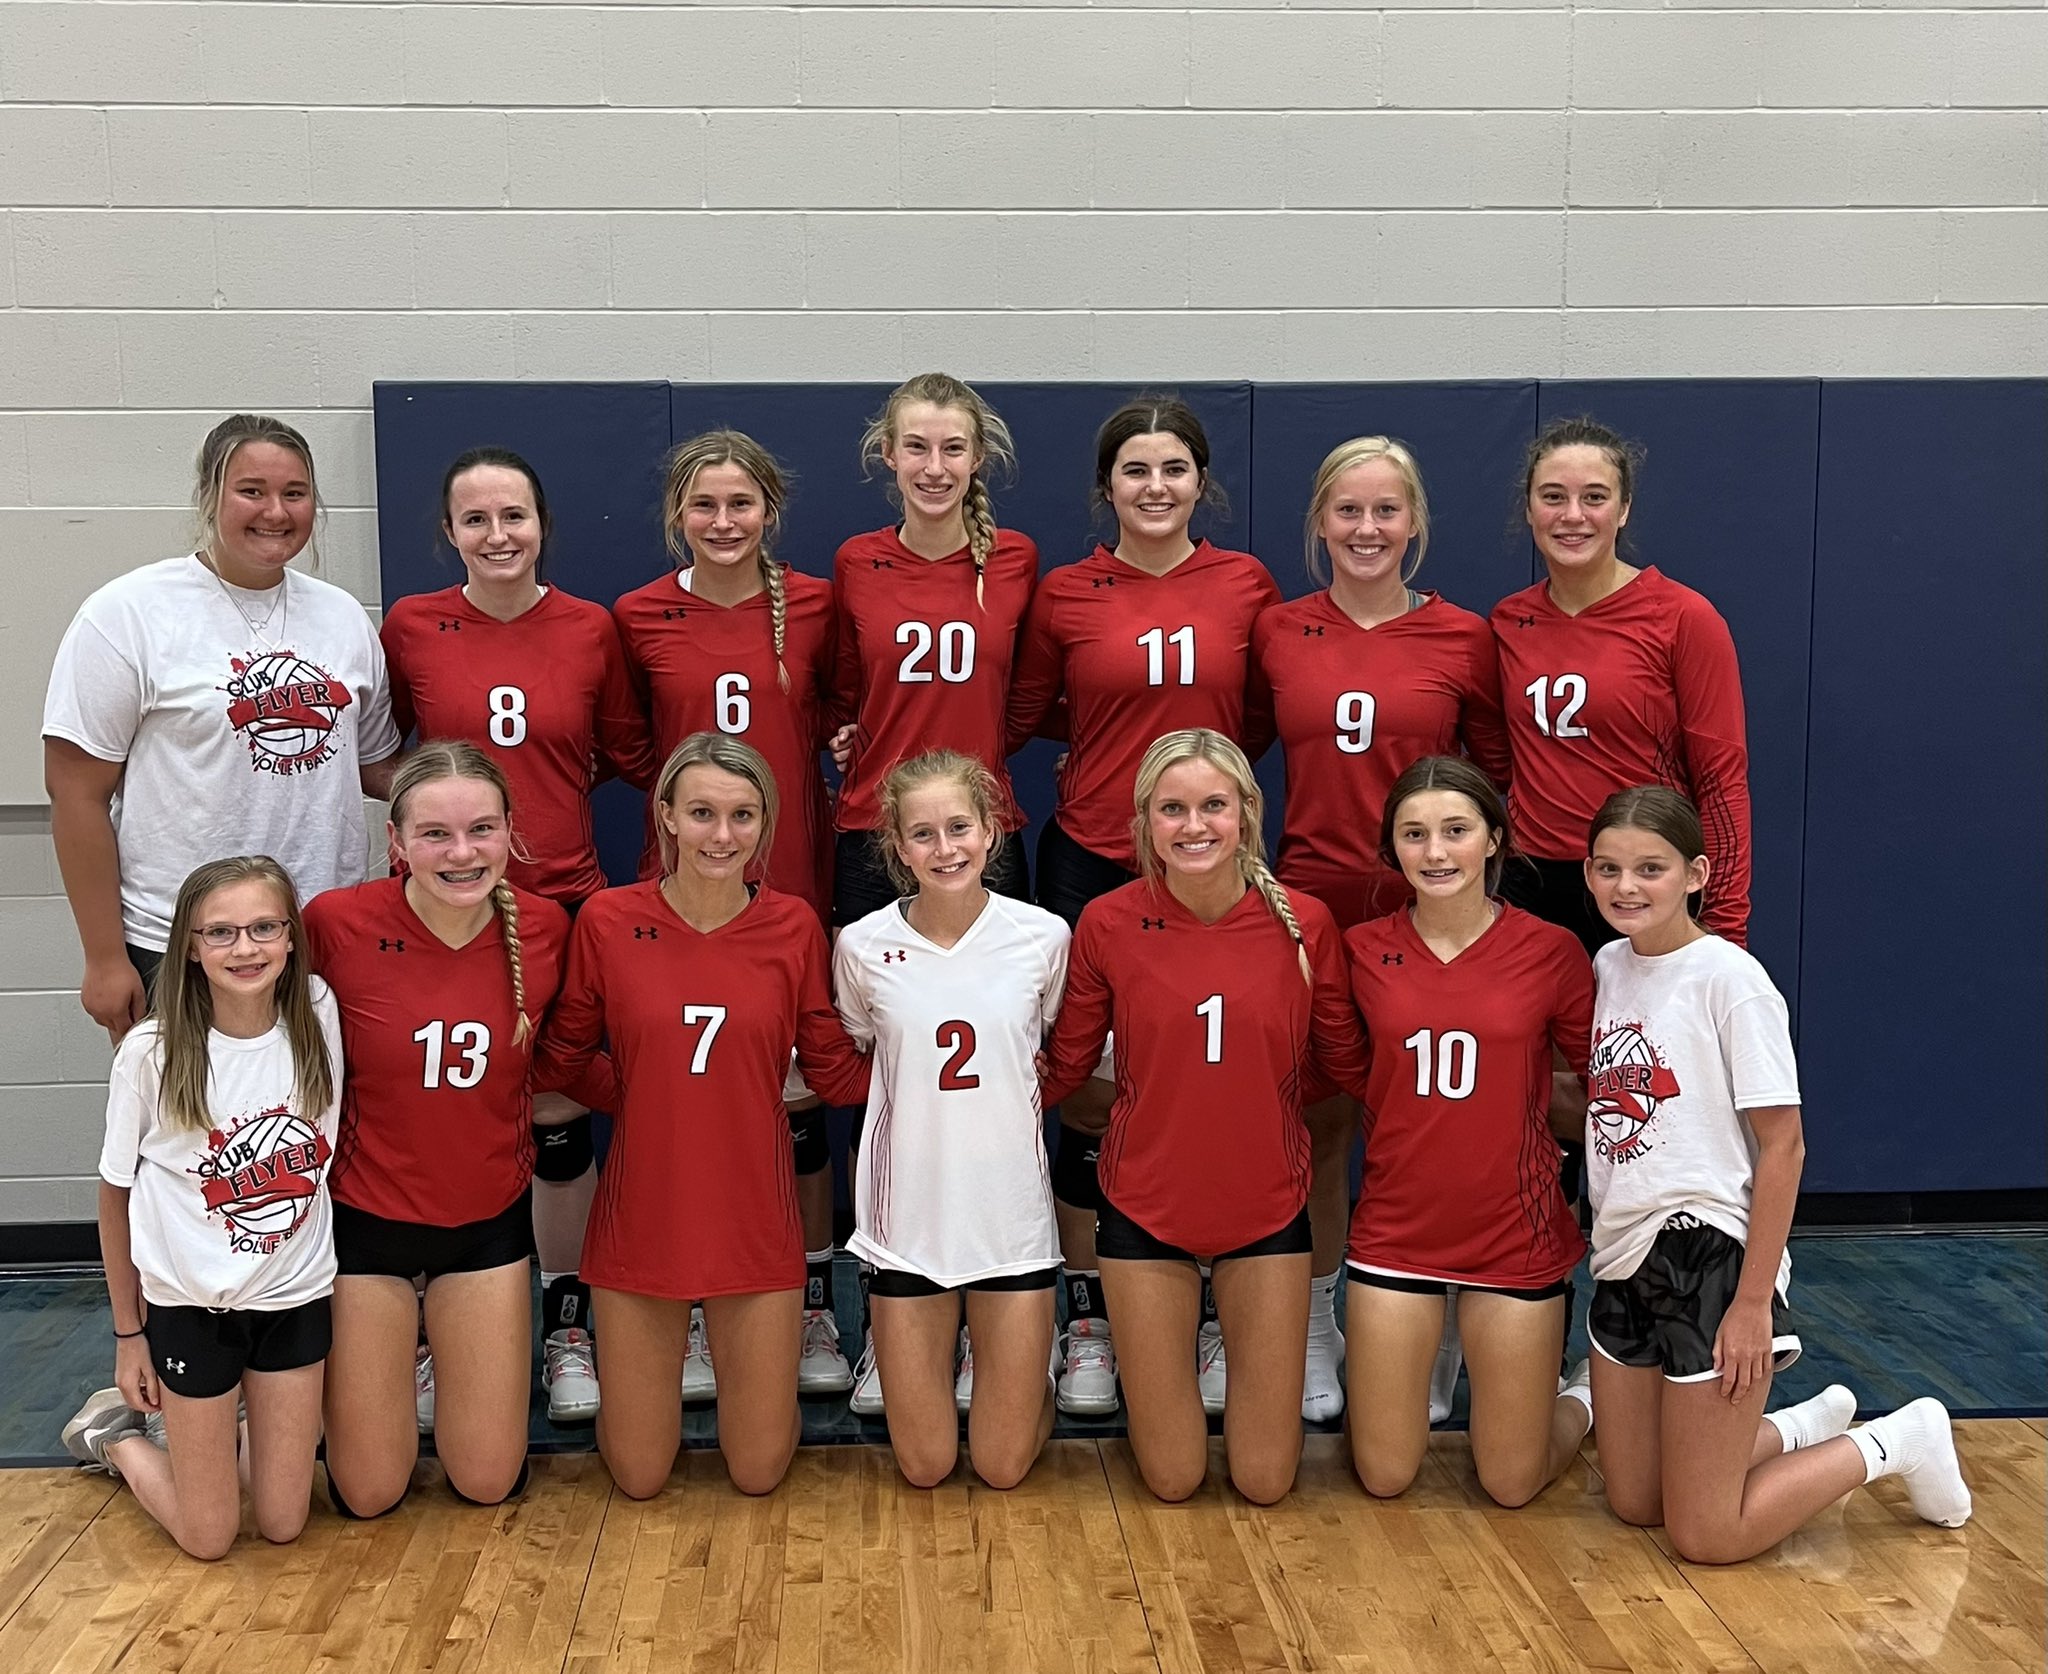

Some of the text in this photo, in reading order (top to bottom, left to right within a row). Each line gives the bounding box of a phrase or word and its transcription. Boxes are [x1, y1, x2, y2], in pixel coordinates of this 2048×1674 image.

[227, 671, 273, 697] CLUB
[895, 620, 977, 684] 20
[1136, 625, 1197, 687] 11
[253, 682, 332, 718] FLYER
[487, 684, 528, 748] 8
[714, 672, 752, 735] 6
[1334, 690, 1376, 754] 9
[1524, 672, 1590, 739] 12
[251, 745, 338, 776] VOLLEYBALL
[413, 1019, 491, 1089] 13
[683, 1004, 728, 1075] 7
[936, 1020, 980, 1090] 2
[1195, 994, 1225, 1064] 1
[1404, 1028, 1480, 1100] 10
[1595, 1066, 1653, 1098] FLYER
[198, 1141, 255, 1178] CLUB
[227, 1141, 318, 1198] FLYER
